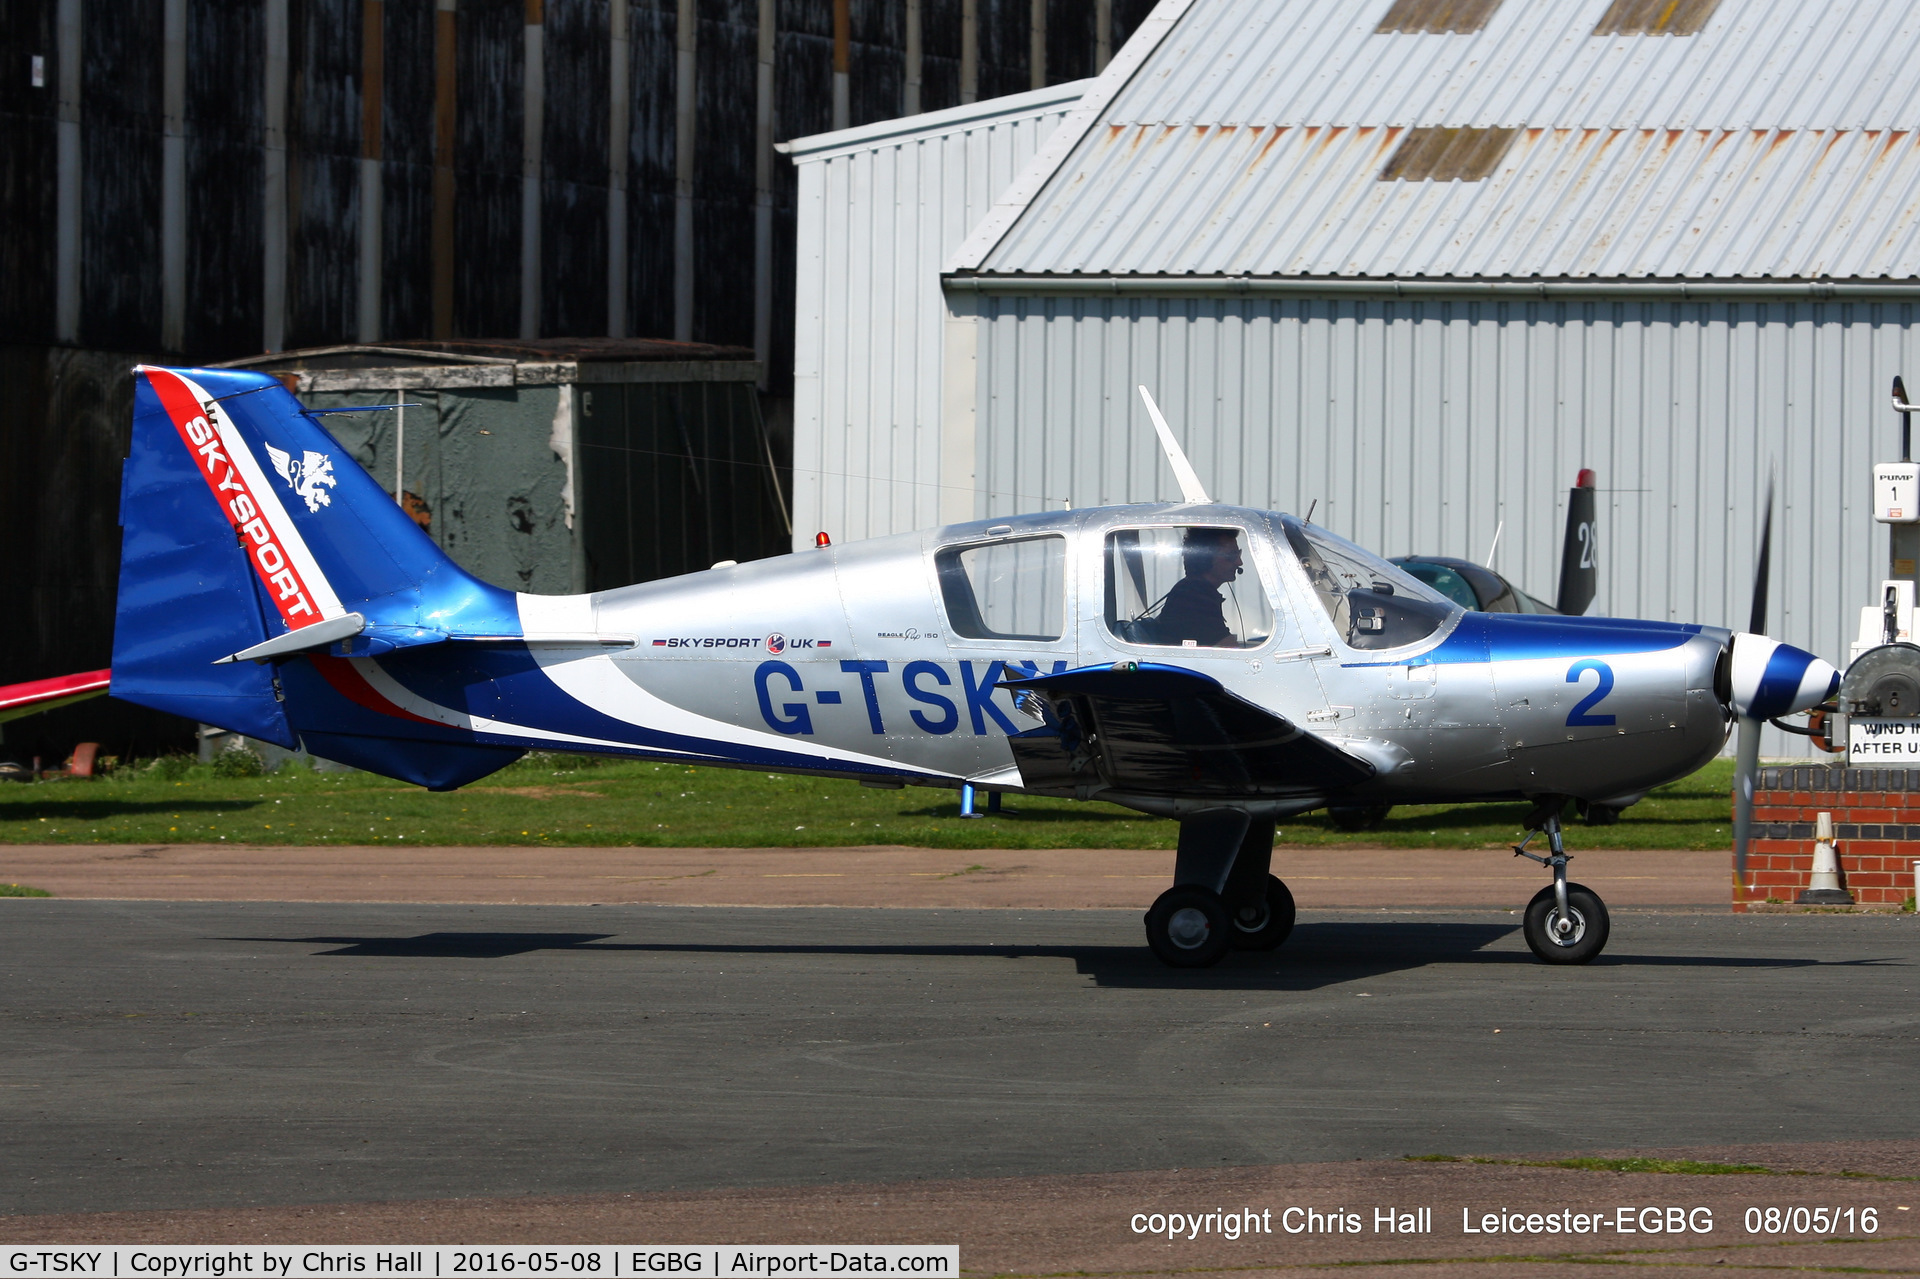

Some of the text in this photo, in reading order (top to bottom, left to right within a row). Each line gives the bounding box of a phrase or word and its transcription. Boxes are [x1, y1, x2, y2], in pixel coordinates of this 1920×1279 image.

[1891, 486, 1897, 501] 1
[185, 415, 313, 617] SKYSPORT
[667, 638, 814, 648] SKYSPORT UK
[1565, 658, 1616, 727] 2
[1864, 723, 1905, 735] WIND
[1852, 742, 1920, 754] AFTER U
